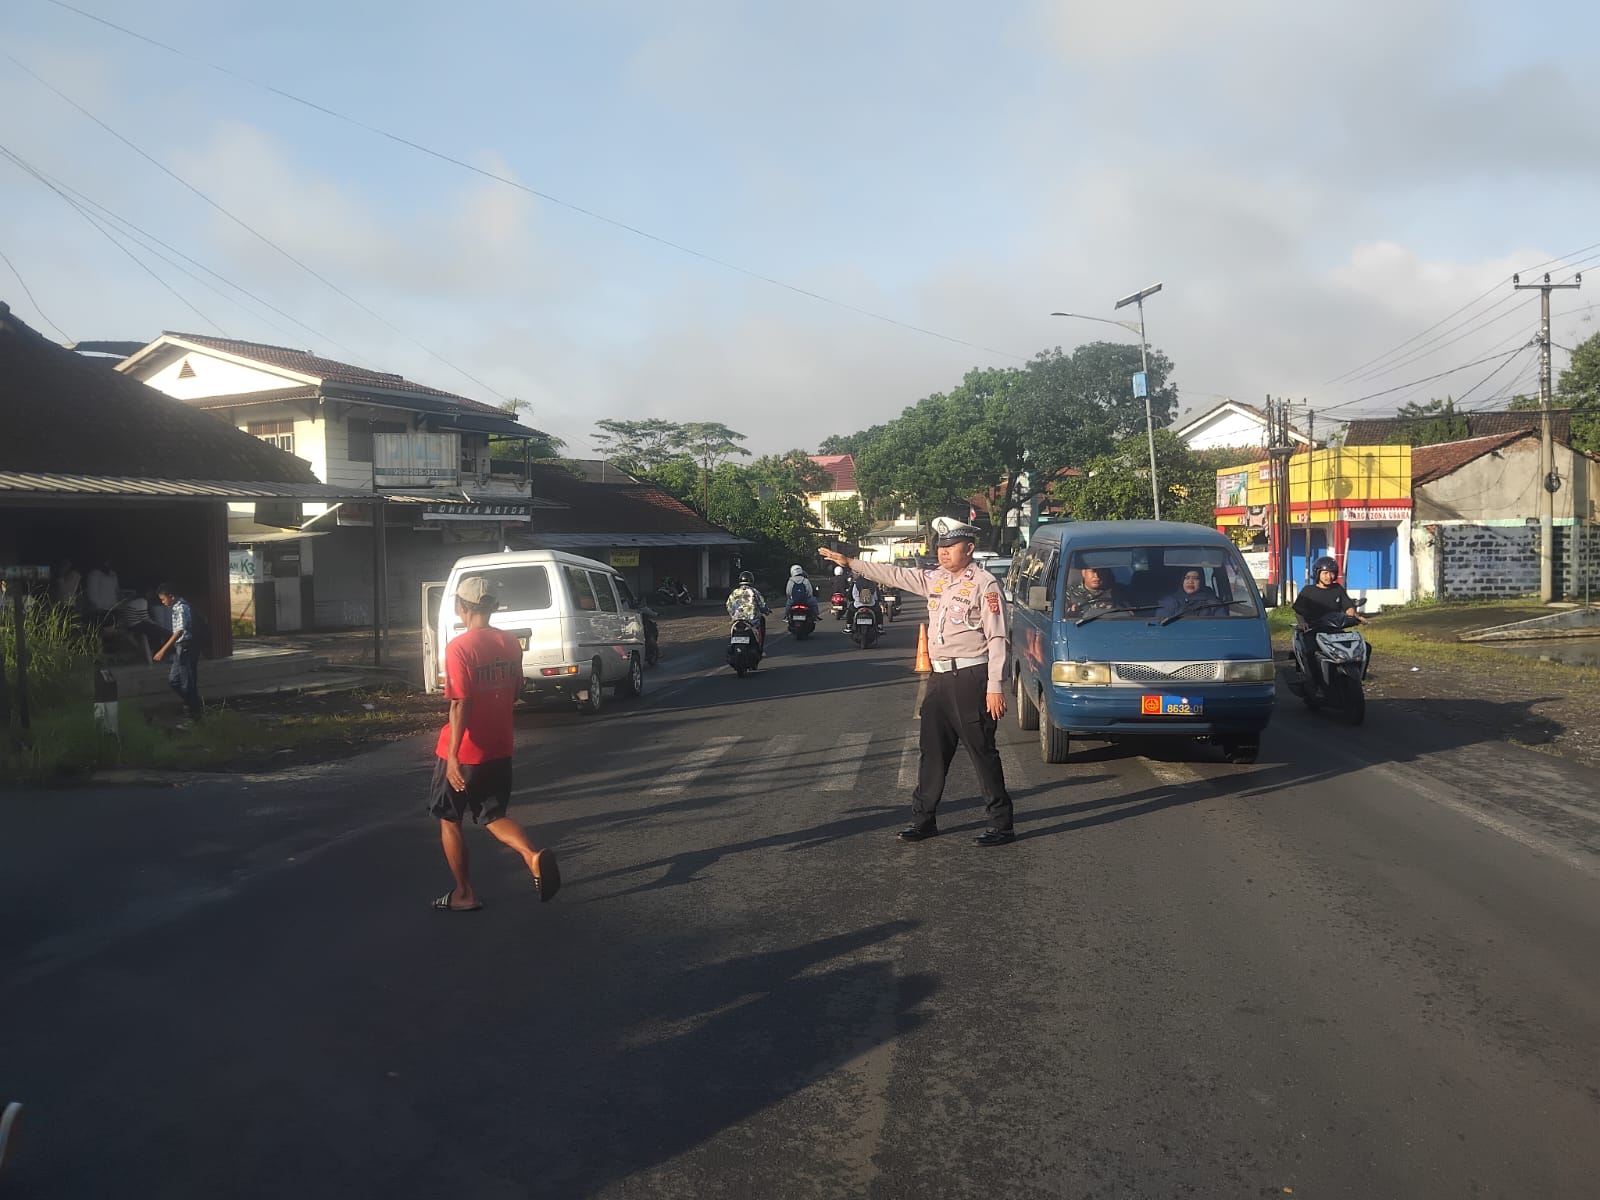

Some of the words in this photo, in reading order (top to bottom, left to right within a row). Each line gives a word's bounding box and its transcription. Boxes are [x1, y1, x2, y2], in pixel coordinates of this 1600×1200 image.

[241, 559, 256, 575] K3
[952, 596, 971, 605] POLRI
[1167, 703, 1203, 713] 8632-01
